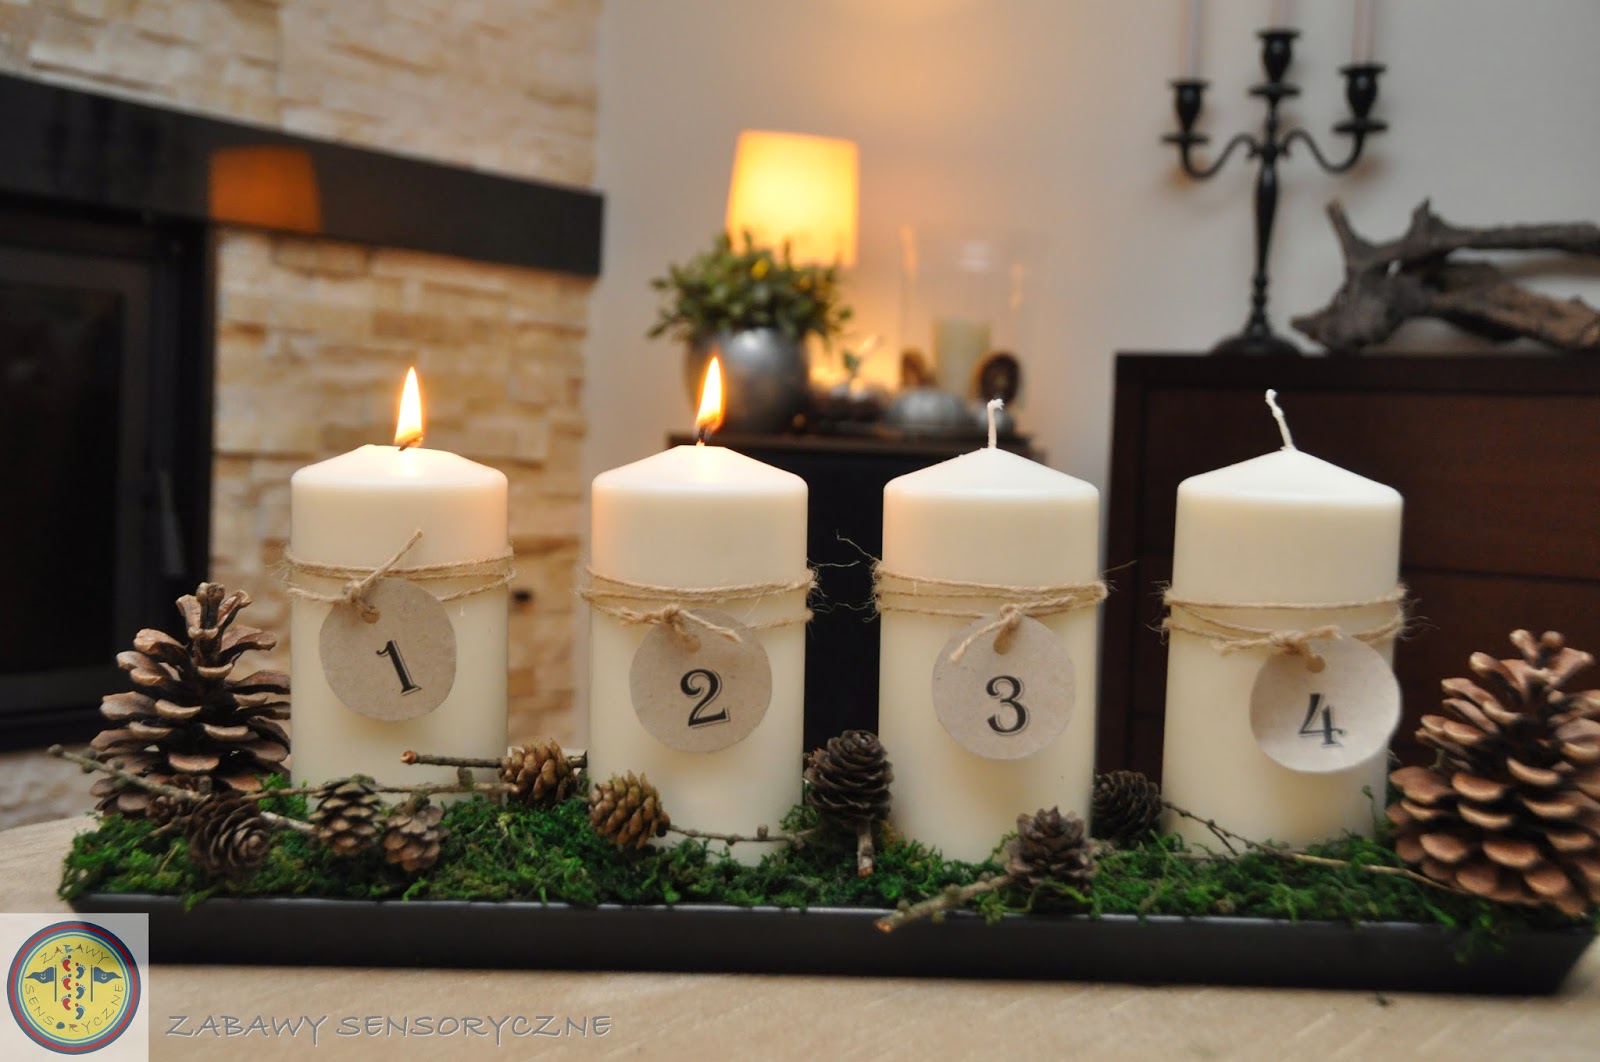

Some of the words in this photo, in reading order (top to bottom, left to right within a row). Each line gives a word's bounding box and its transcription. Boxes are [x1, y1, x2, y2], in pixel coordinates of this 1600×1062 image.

[376, 640, 422, 696] 1
[680, 668, 731, 729] 2
[986, 675, 1030, 736] 3
[1298, 692, 1347, 748] 4
